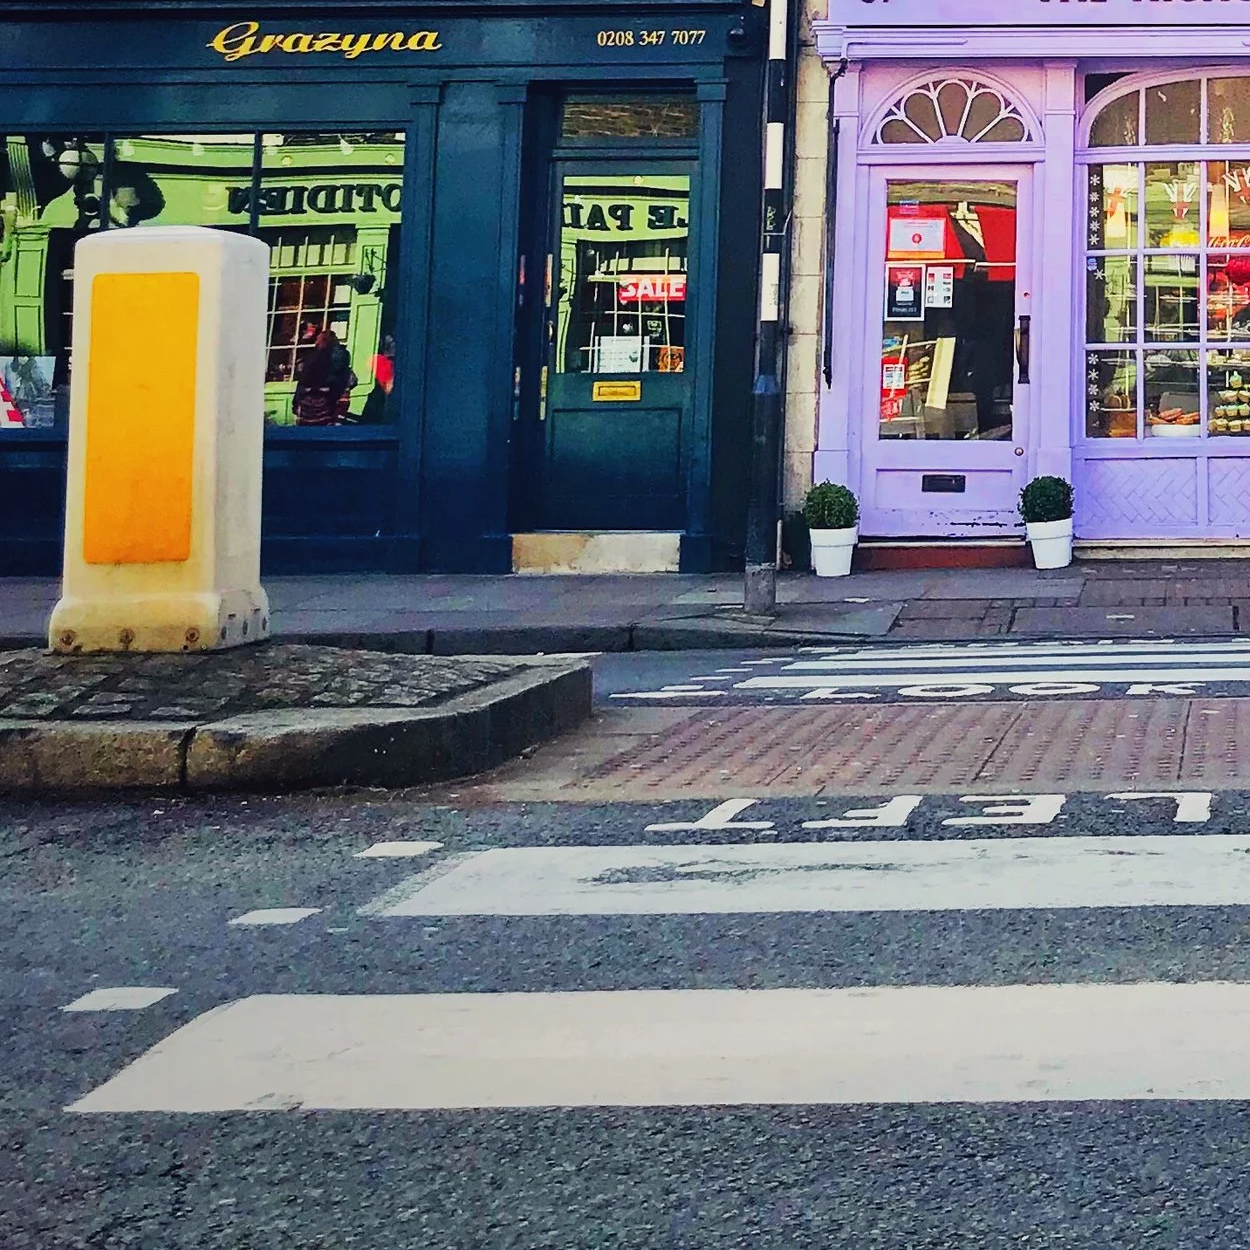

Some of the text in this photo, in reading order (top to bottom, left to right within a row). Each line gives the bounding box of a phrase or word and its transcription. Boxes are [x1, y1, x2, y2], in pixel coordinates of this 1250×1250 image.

[205, 21, 443, 62] Grazyna
[597, 30, 706, 46] 0208 347 7077
[620, 280, 684, 298] SALE
[801, 682, 1206, 699] LOOK
[644, 791, 1212, 832] LEFT
